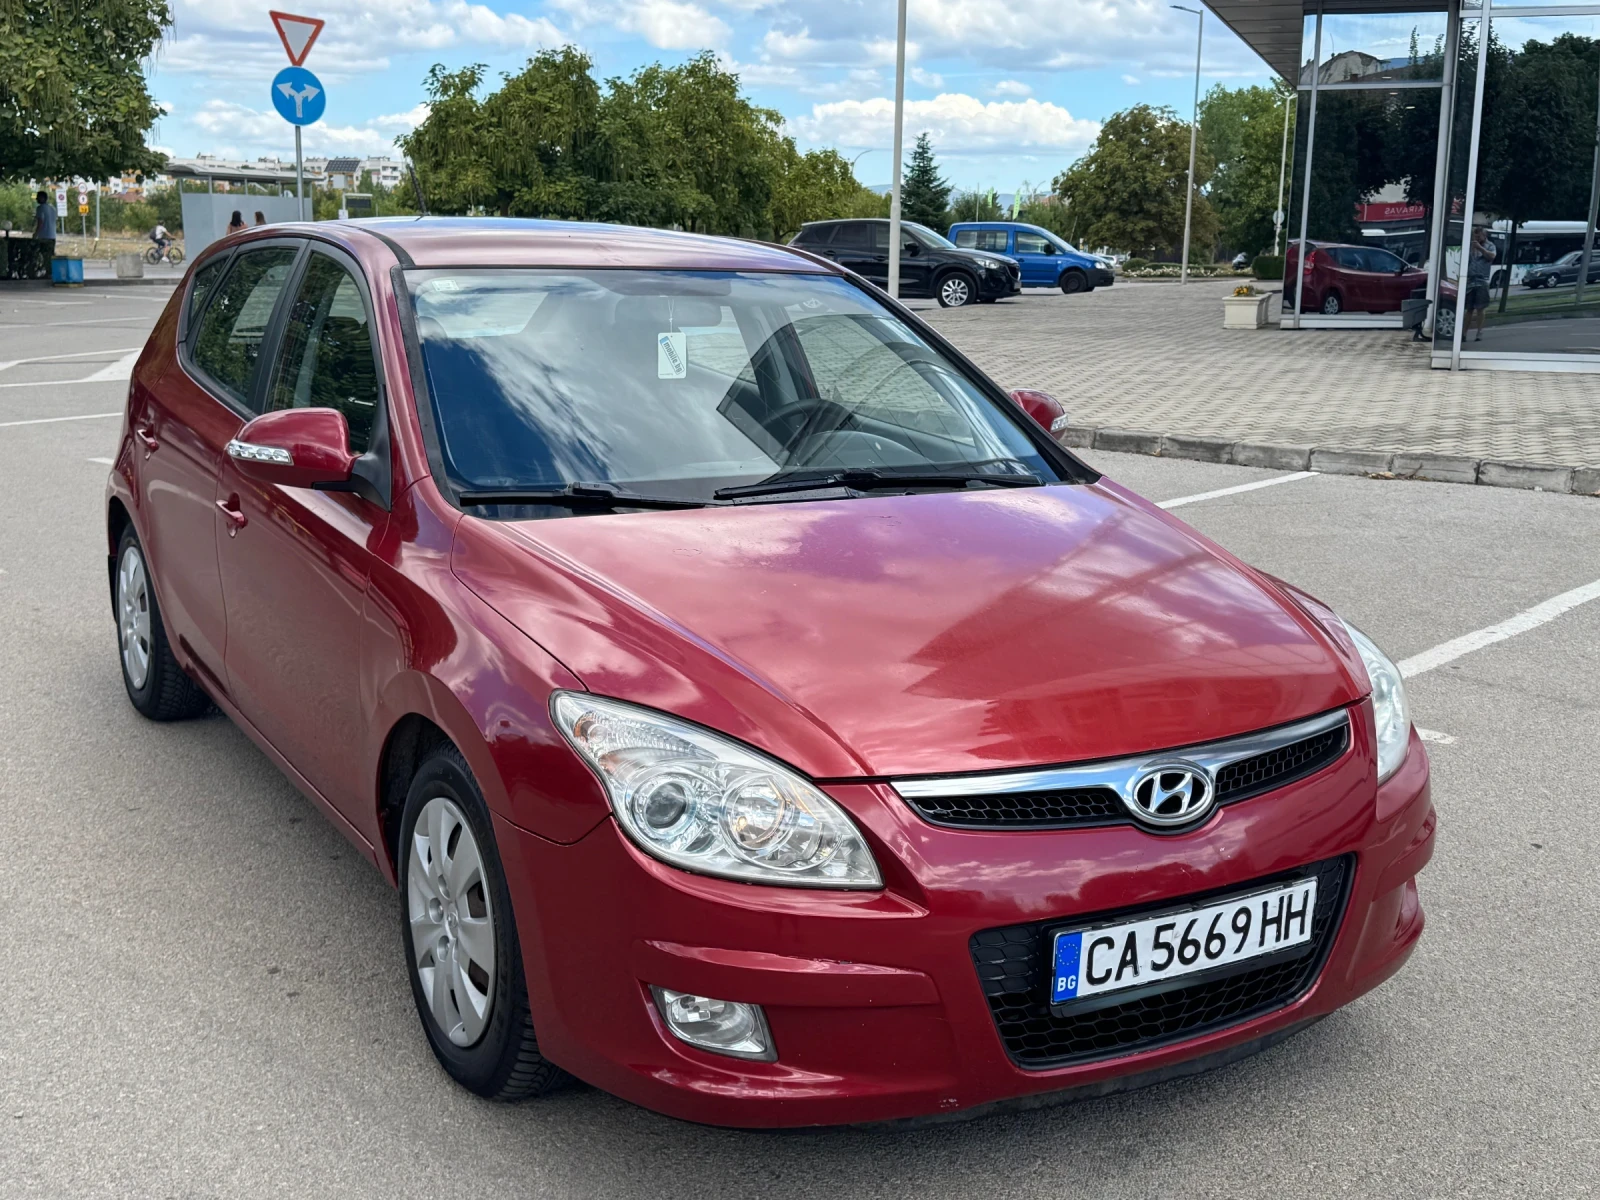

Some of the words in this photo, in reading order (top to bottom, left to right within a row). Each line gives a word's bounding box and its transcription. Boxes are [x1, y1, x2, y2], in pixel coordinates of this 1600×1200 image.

[1086, 931, 1140, 986] CA
[1151, 906, 1252, 971] 5669
[1259, 889, 1309, 947] HH
[1057, 975, 1077, 992] BG
